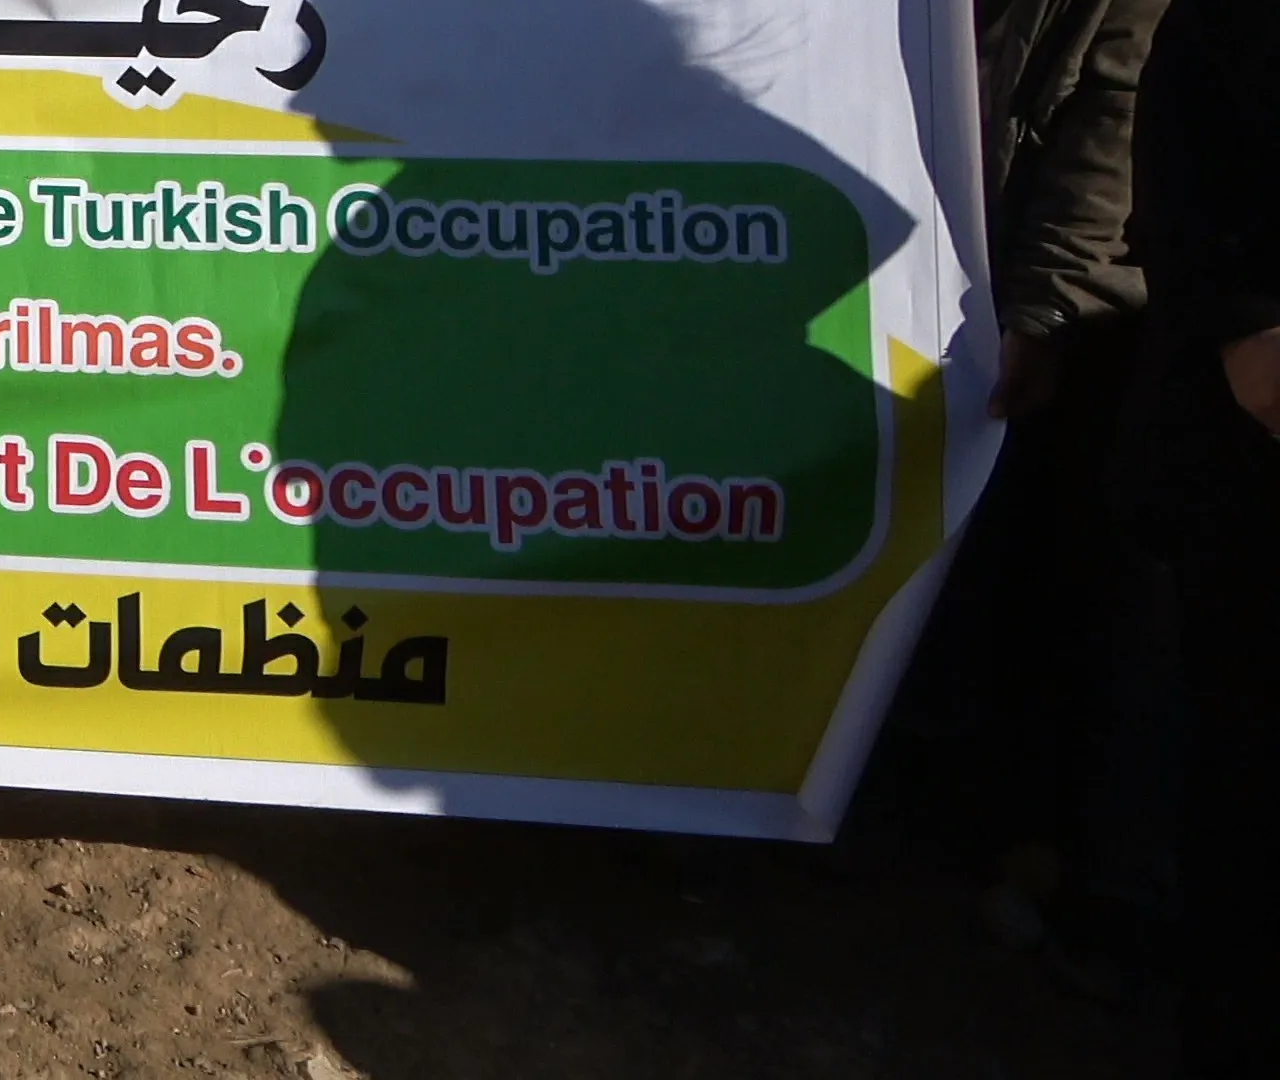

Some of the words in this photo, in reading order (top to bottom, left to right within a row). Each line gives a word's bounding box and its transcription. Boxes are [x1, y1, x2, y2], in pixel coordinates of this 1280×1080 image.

[37, 184, 310, 246] Turkish
[336, 188, 780, 269] Occupation
[55, 440, 163, 510] De
[16, 591, 450, 706] منظمات
